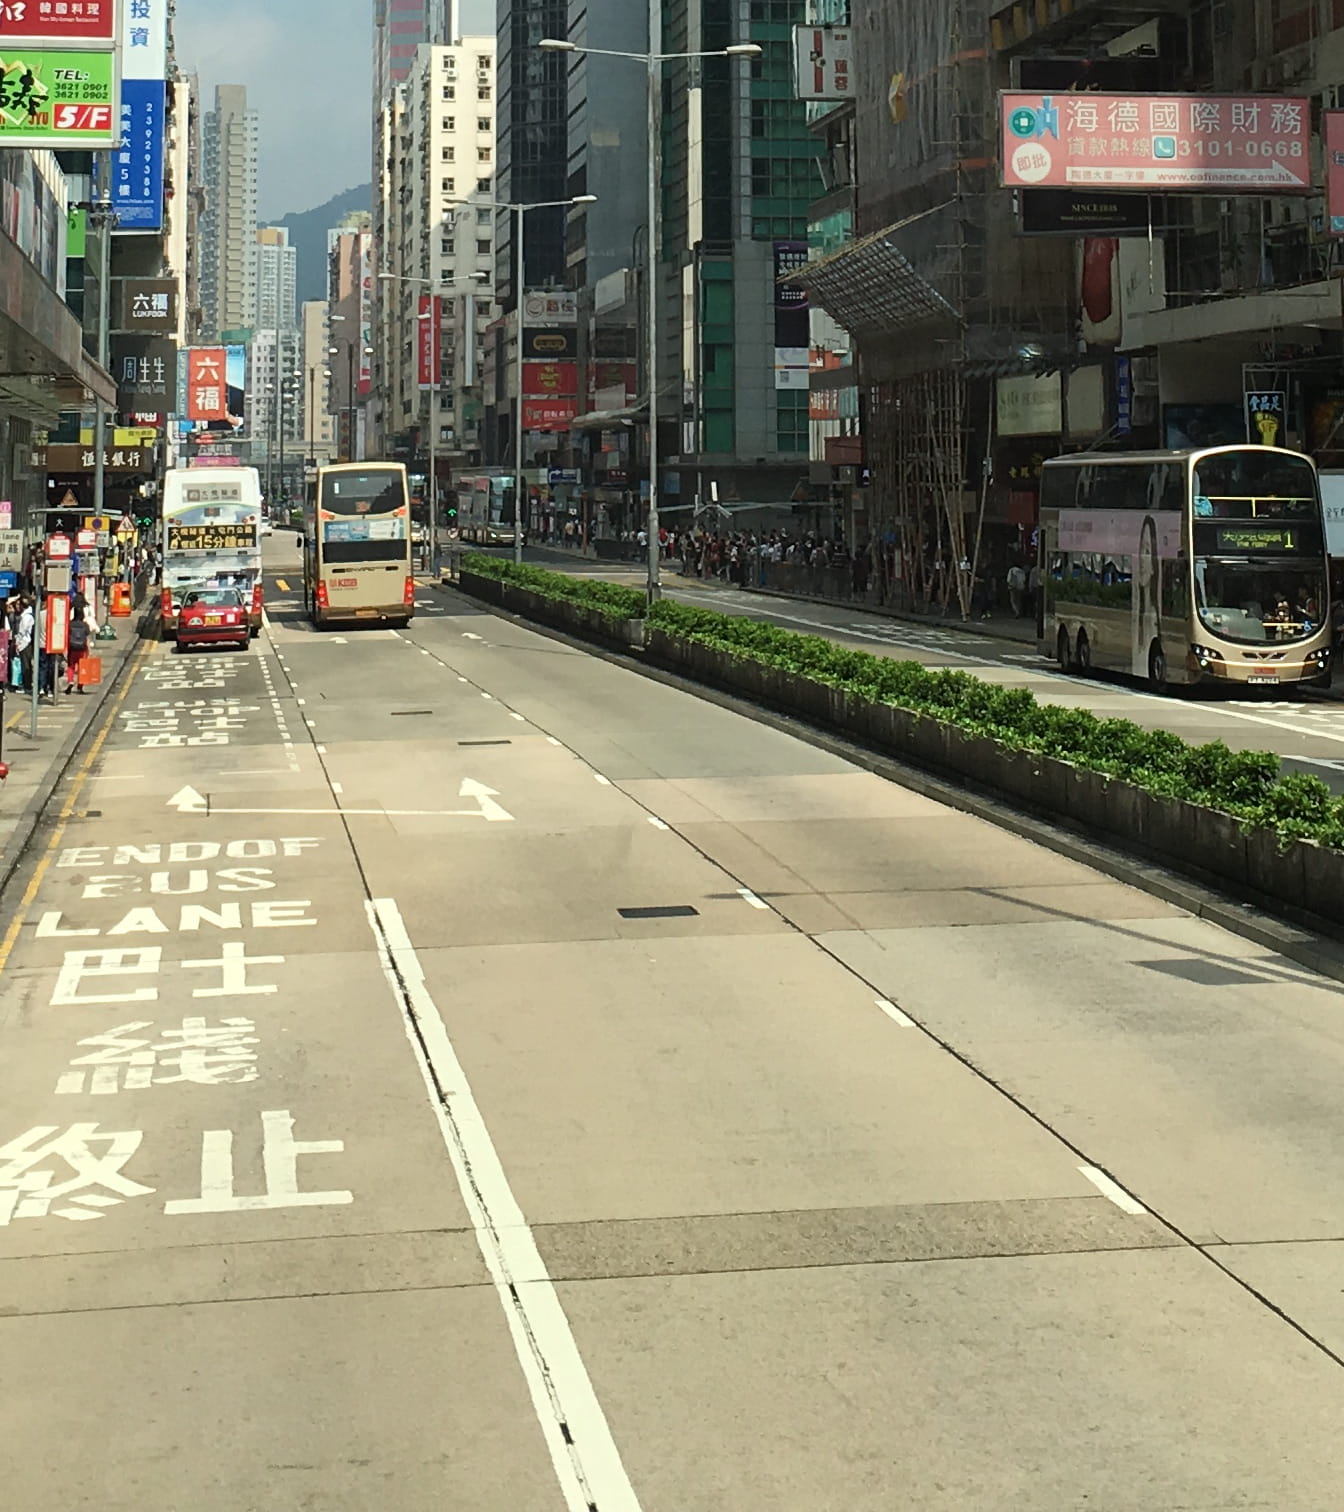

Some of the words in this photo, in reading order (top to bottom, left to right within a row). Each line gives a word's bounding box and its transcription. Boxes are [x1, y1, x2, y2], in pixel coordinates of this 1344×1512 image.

[54, 70, 88, 80] TEL:
[57, 106, 109, 128] 5/F
[1067, 100, 1302, 135] 海德國際財務
[144, 103, 152, 196] 23929388
[1067, 137, 1151, 157] 貸款熱線
[1178, 140, 1303, 157] 3101-0668
[1017, 152, 1047, 172] 即批
[134, 293, 168, 310] 六福
[122, 357, 165, 383] 周生生
[196, 357, 219, 411] 六福
[1285, 533, 1294, 548] 1
[124, 717, 247, 732] 巴士
[138, 732, 230, 748] 站
[55, 840, 224, 869] END
[35, 899, 319, 938] LANE
[48, 941, 286, 1006] 巴士
